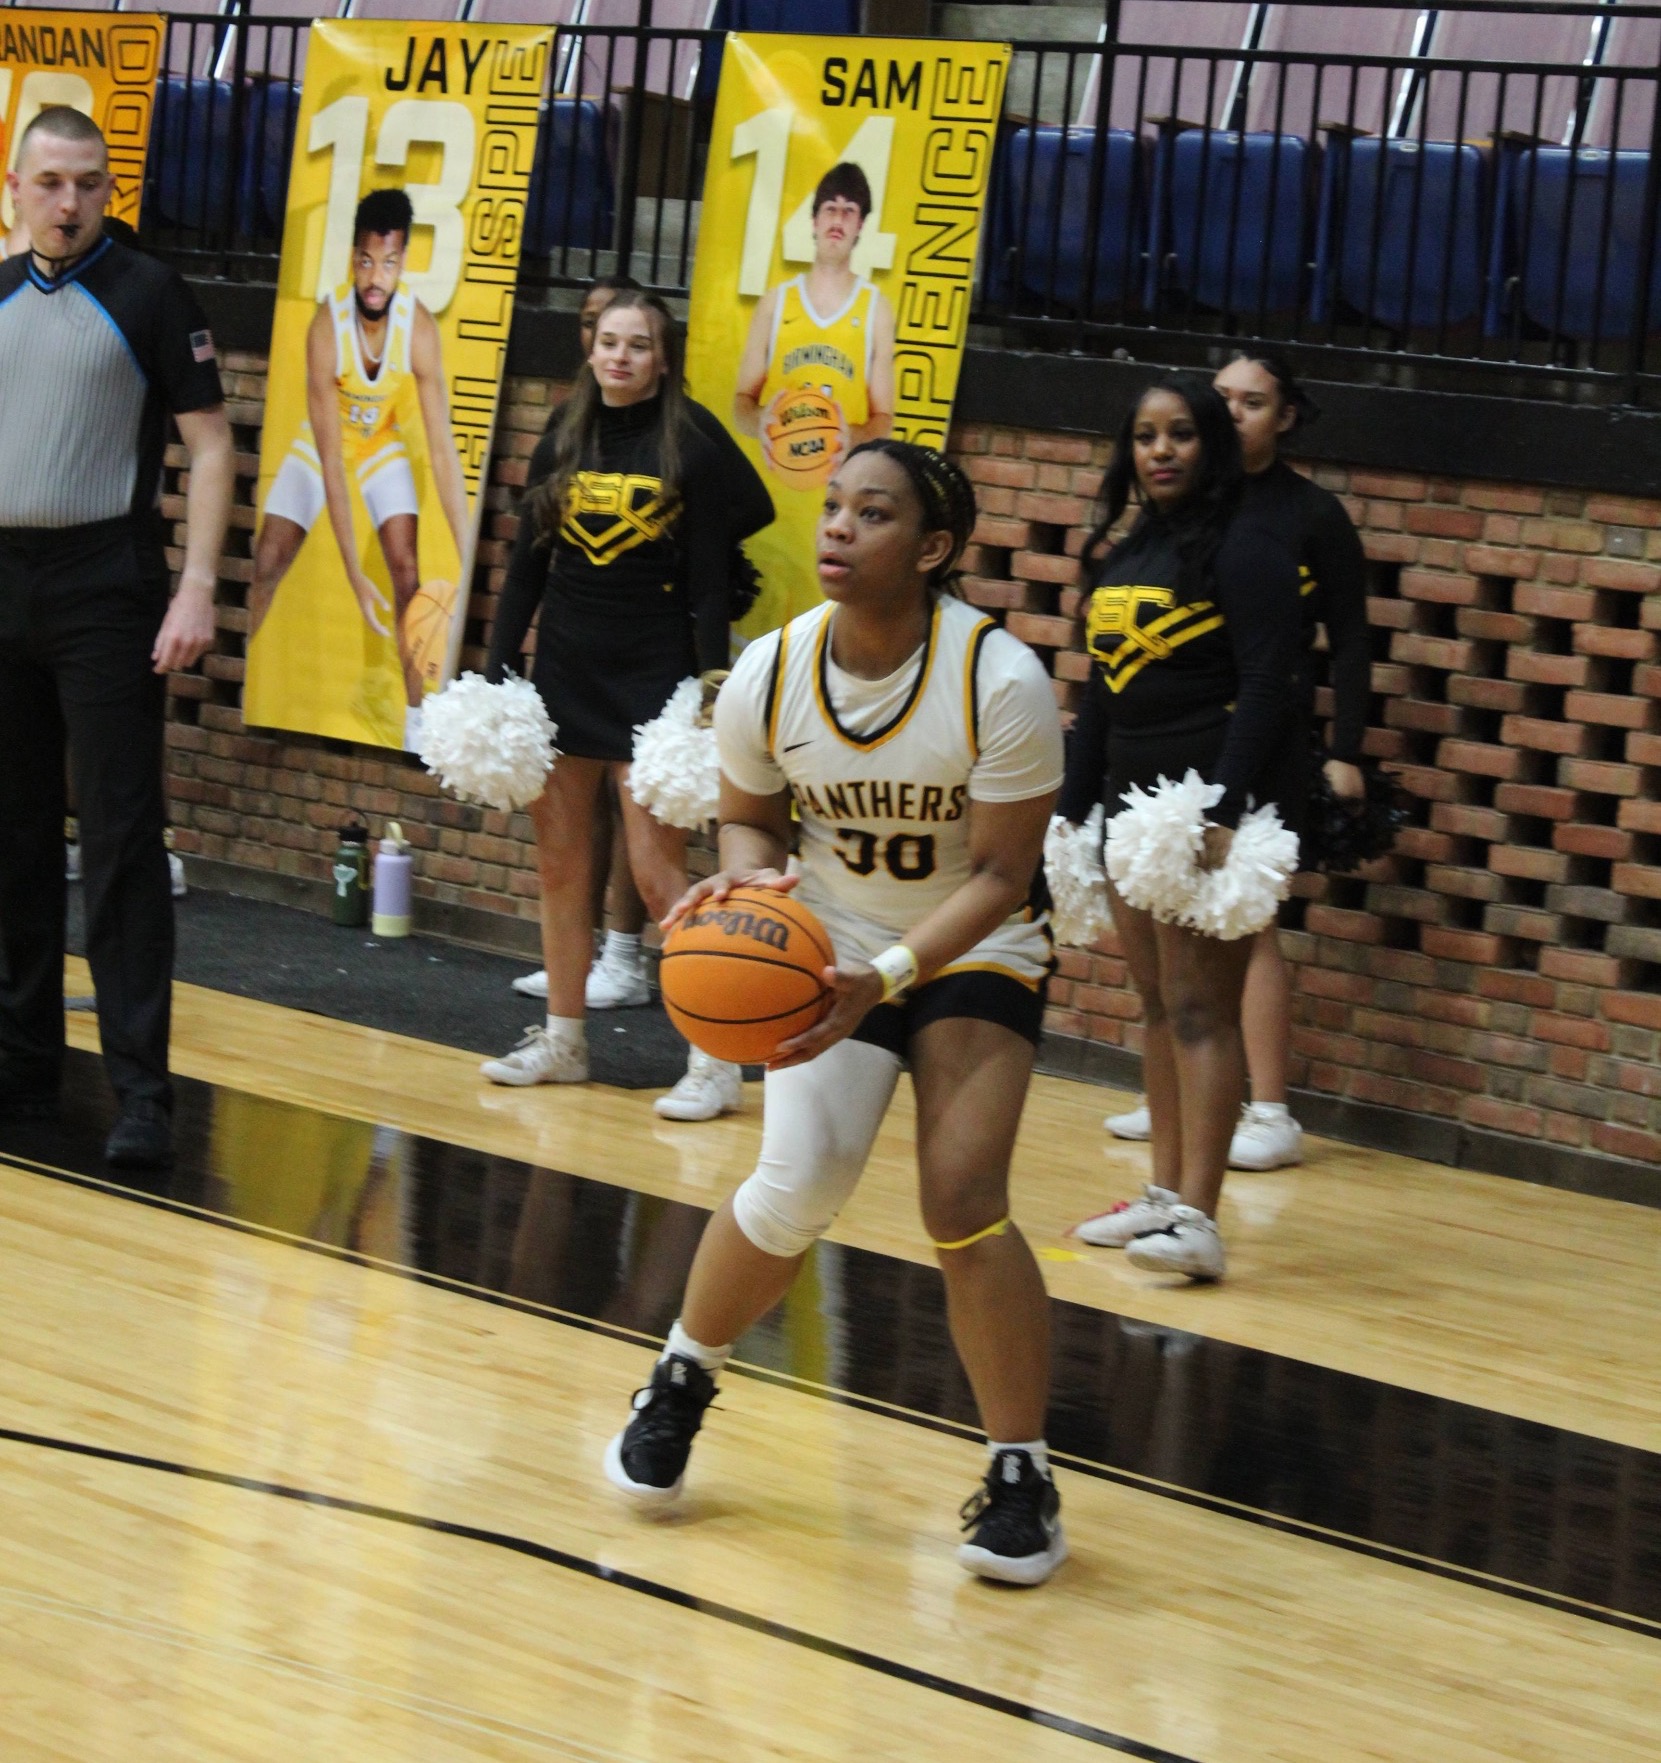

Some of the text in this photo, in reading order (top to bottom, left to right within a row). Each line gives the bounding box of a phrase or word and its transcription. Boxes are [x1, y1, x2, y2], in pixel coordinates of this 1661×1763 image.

[0, 23, 106, 67] ANDAN
[384, 36, 490, 95] JAY
[820, 56, 923, 111] SAM
[308, 95, 477, 314] 13
[730, 105, 897, 296] 14
[682, 909, 789, 952] Wilson
